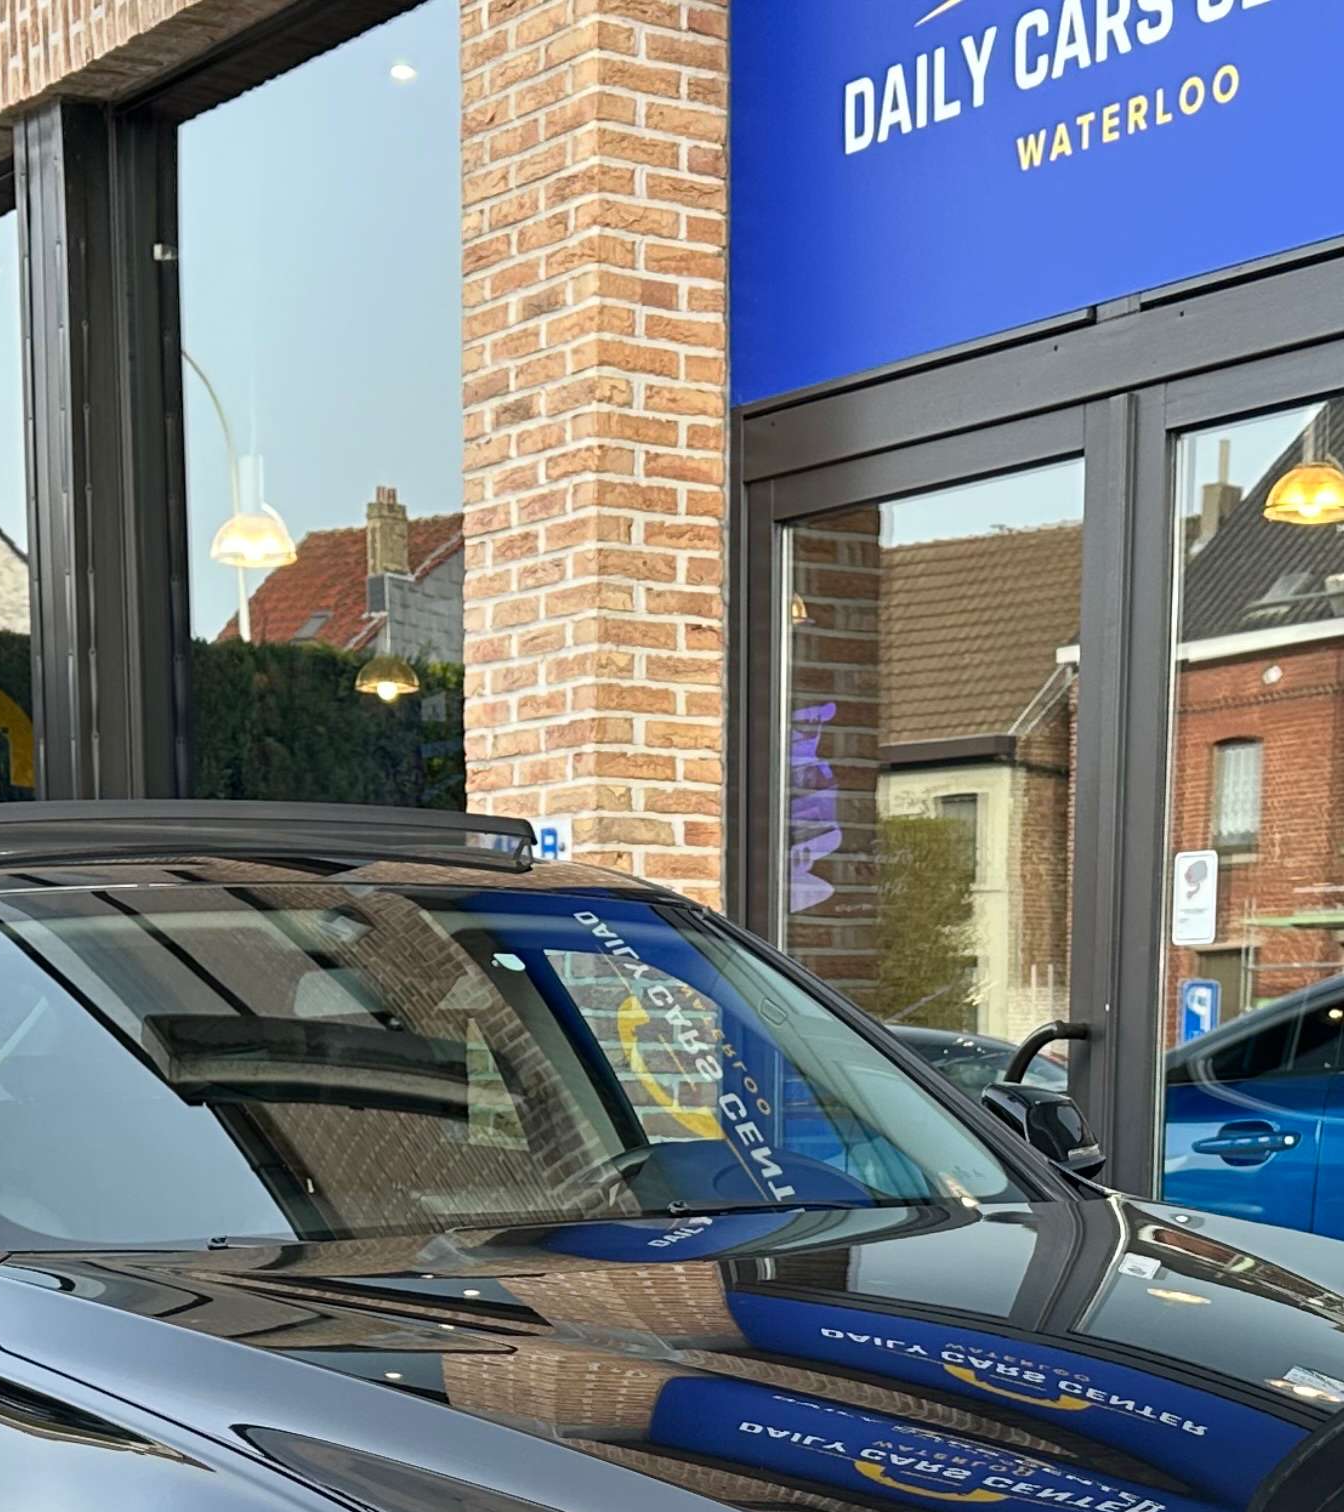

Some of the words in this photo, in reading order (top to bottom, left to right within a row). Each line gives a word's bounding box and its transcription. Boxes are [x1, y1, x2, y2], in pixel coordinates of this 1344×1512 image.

[843, 26, 998, 156] DAILY
[1013, 0, 1175, 91] CARS
[1016, 63, 1240, 172] WATERLOO
